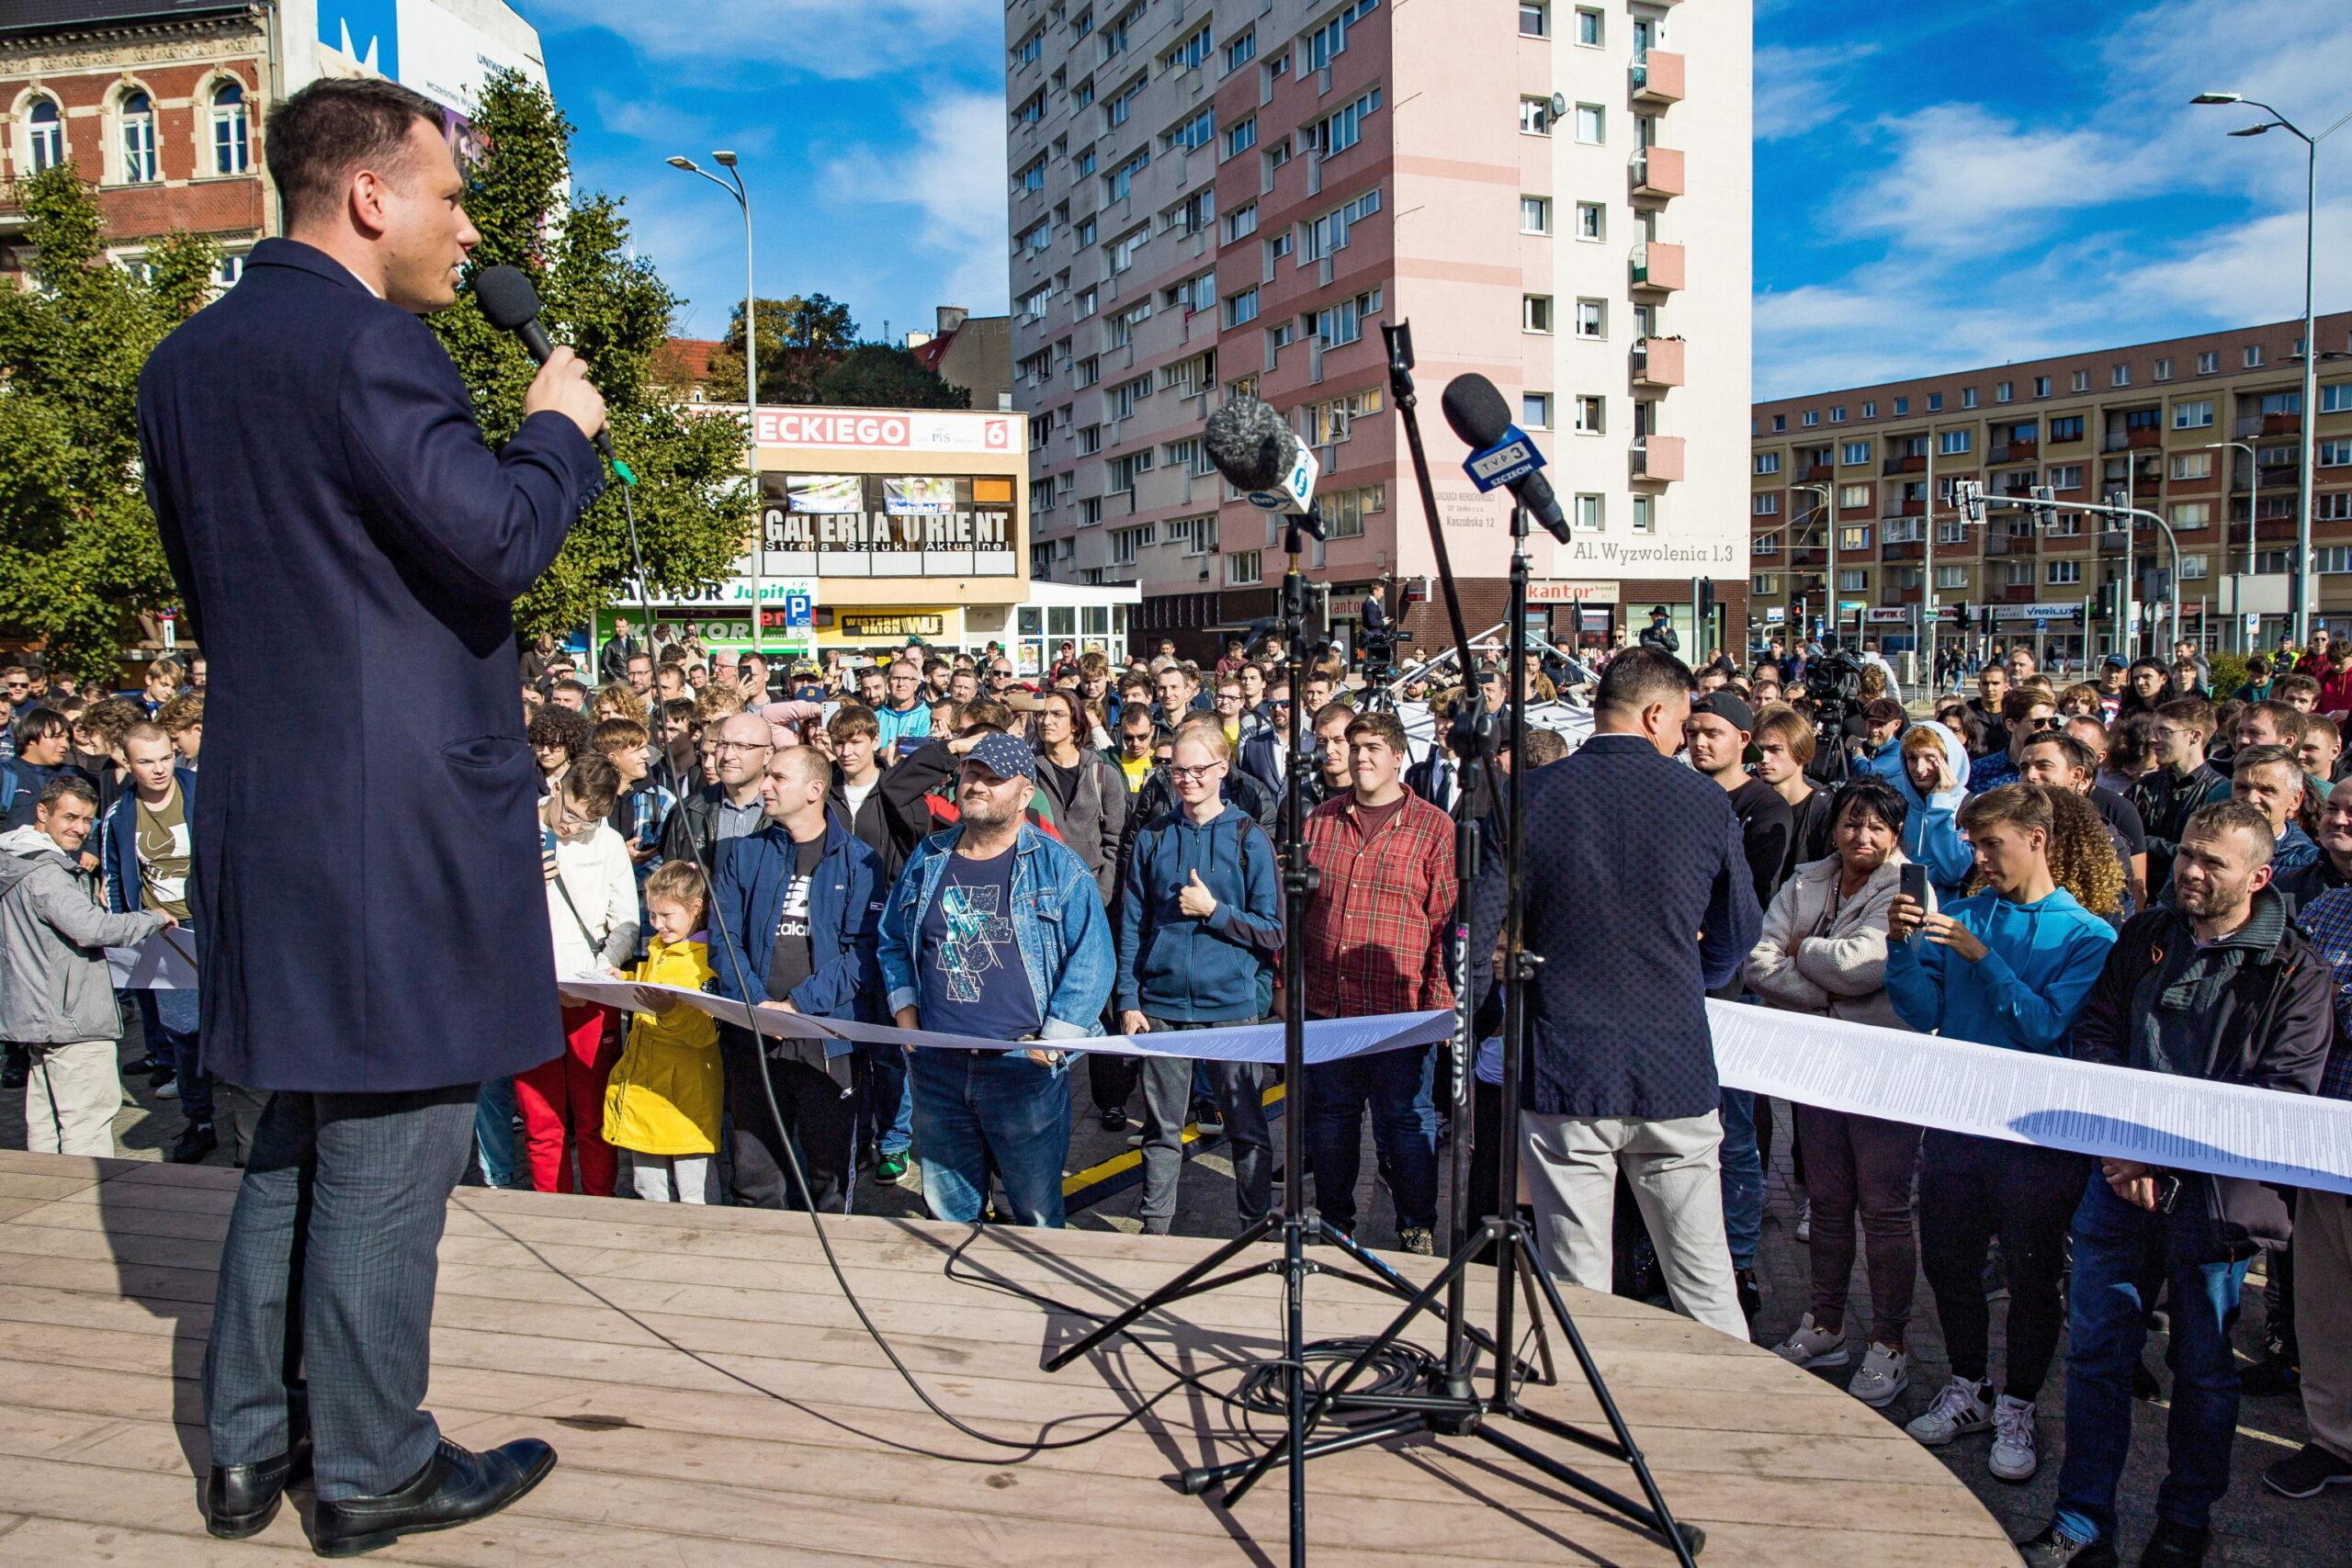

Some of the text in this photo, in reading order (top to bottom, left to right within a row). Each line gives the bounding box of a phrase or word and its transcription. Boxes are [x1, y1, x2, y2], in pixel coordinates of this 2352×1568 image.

[758, 415, 906, 445] ECKIEGO
[988, 422, 1006, 445] 6
[1482, 446, 1524, 471] TVP 3
[1490, 463, 1533, 487] SZCZECIN
[1446, 515, 1484, 528] Kaszubska
[1486, 516, 1495, 528] 12
[765, 541, 1010, 553] Strefa Sztuki Aktualnej
[1574, 542, 1734, 566] Al. Wyzwolenia 1,3
[1529, 584, 1595, 599] kantor
[791, 597, 807, 618] P
[845, 617, 901, 626] WESTERN
[861, 626, 901, 634] UNION
[2039, 618, 2046, 627] P
